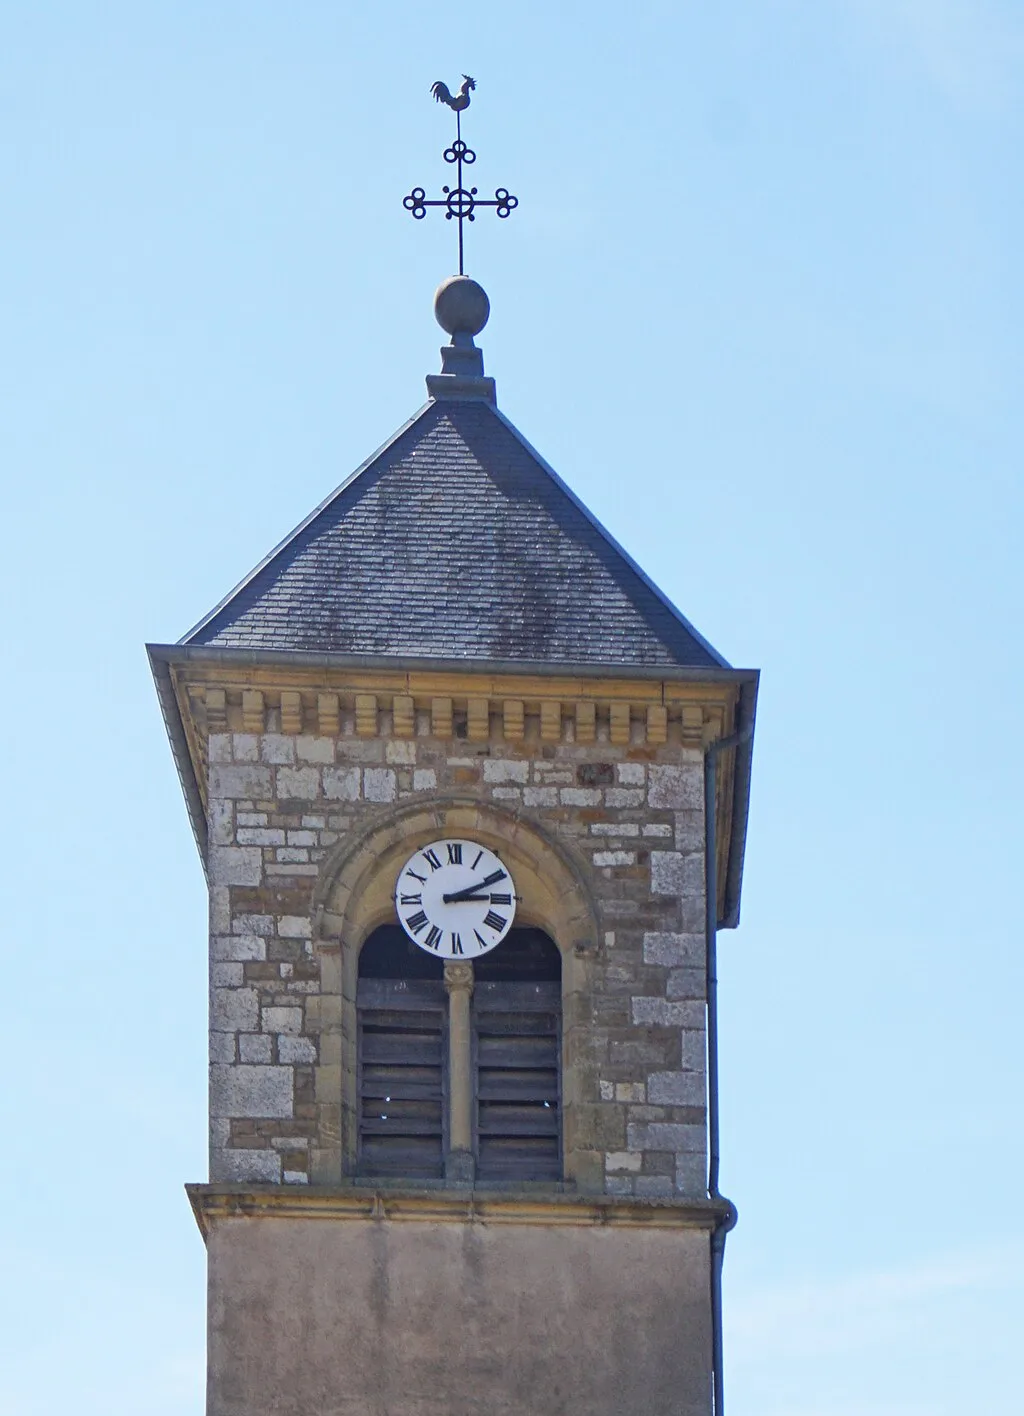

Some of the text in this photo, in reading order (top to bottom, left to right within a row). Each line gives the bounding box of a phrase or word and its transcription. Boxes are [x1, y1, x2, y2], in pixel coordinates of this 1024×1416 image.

[422, 849, 442, 873] XI
[446, 843, 463, 865] XII
[470, 850, 484, 871] I
[405, 867, 427, 887] X
[400, 893, 422, 905] IX
[489, 892, 511, 905] III
[405, 909, 430, 936] VIII
[424, 924, 443, 951] VII
[451, 932, 464, 954] VI
[473, 928, 487, 949] V
